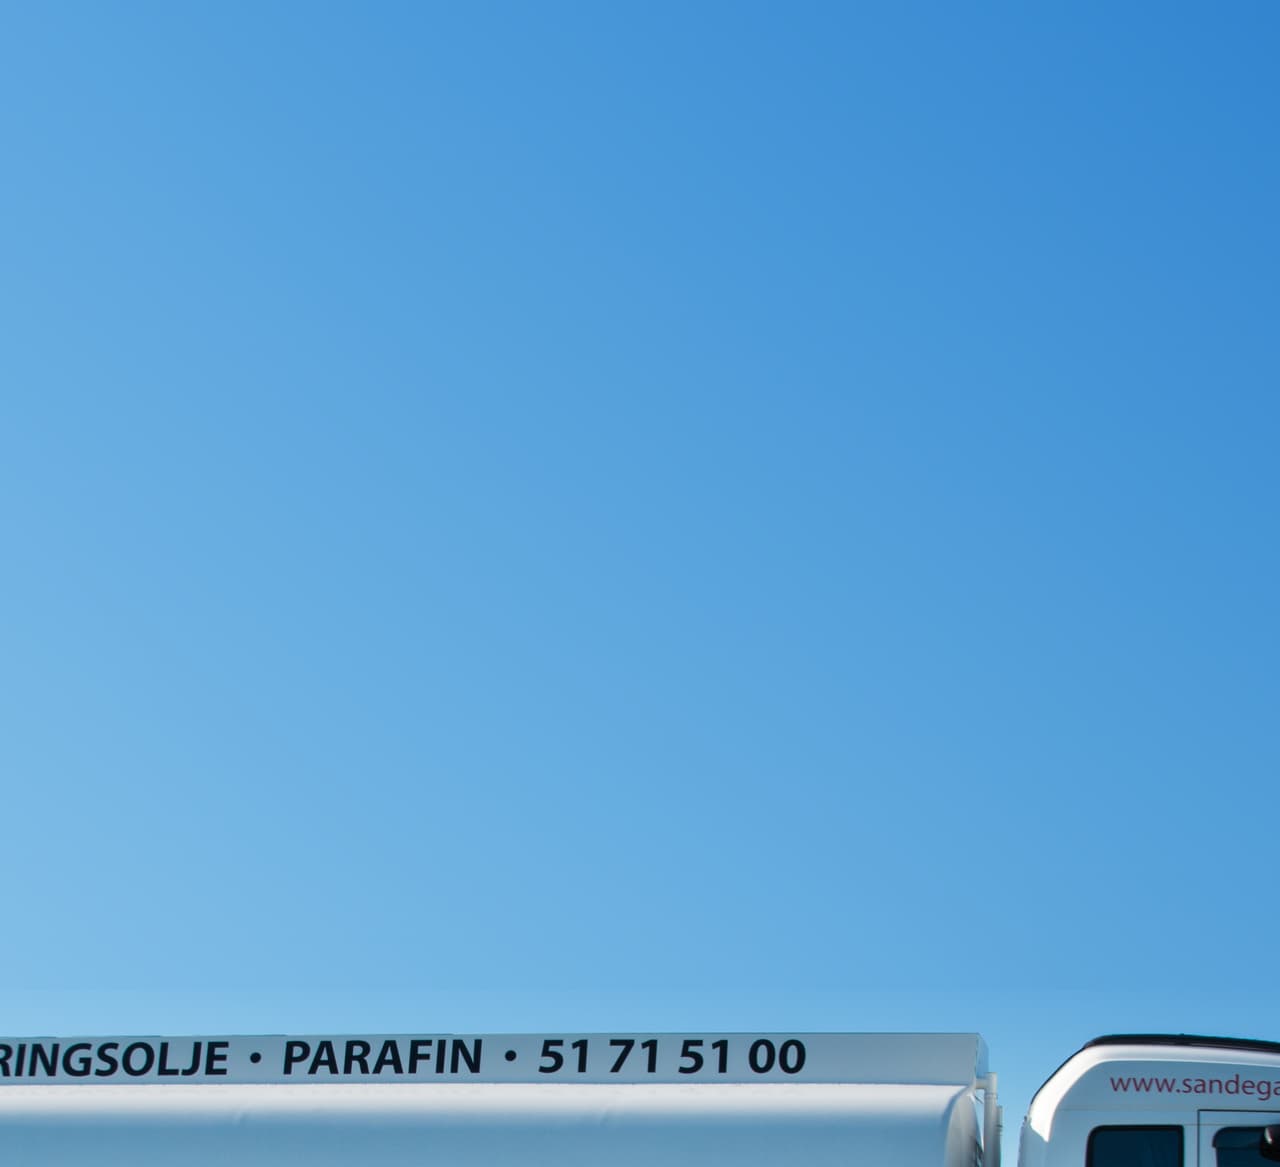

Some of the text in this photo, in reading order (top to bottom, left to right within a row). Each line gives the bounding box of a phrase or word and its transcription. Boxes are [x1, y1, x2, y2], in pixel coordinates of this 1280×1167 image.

[282, 1038, 483, 1075] PARAFIN
[538, 1038, 589, 1074] 51
[609, 1038, 658, 1073] 71
[678, 1039, 729, 1075] 51
[748, 1038, 807, 1075] 00
